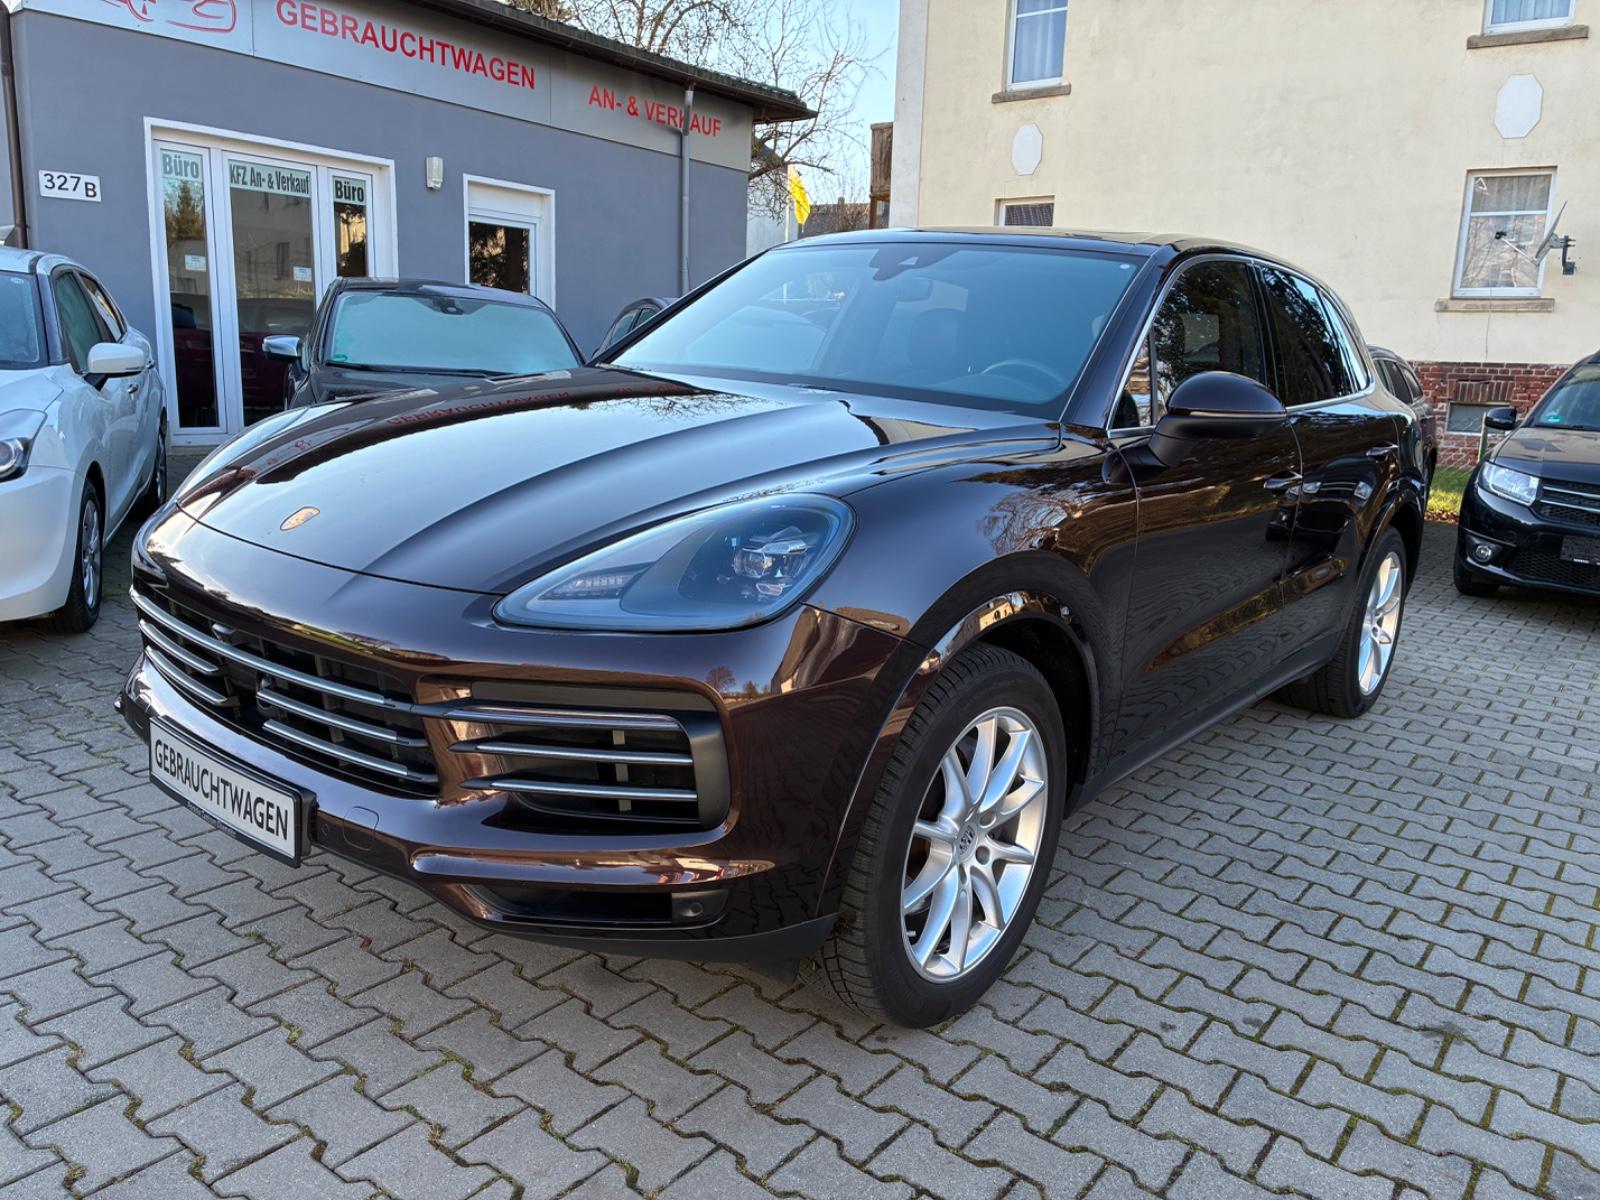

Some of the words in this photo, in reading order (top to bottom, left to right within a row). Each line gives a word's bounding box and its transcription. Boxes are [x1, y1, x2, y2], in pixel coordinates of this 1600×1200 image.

[276, 0, 535, 90] GEBRAUCHTWAGEN
[588, 83, 622, 111] AN-
[627, 95, 639, 117] &
[162, 153, 200, 179] Büro
[228, 163, 248, 186] KFZ
[250, 166, 266, 188] An-
[267, 172, 275, 190] &
[275, 170, 309, 195] Verkauf
[43, 172, 81, 192] 327
[84, 181, 97, 198] B
[334, 180, 365, 203] Büro
[154, 738, 289, 841] GEBRAUCHTWAGEN
